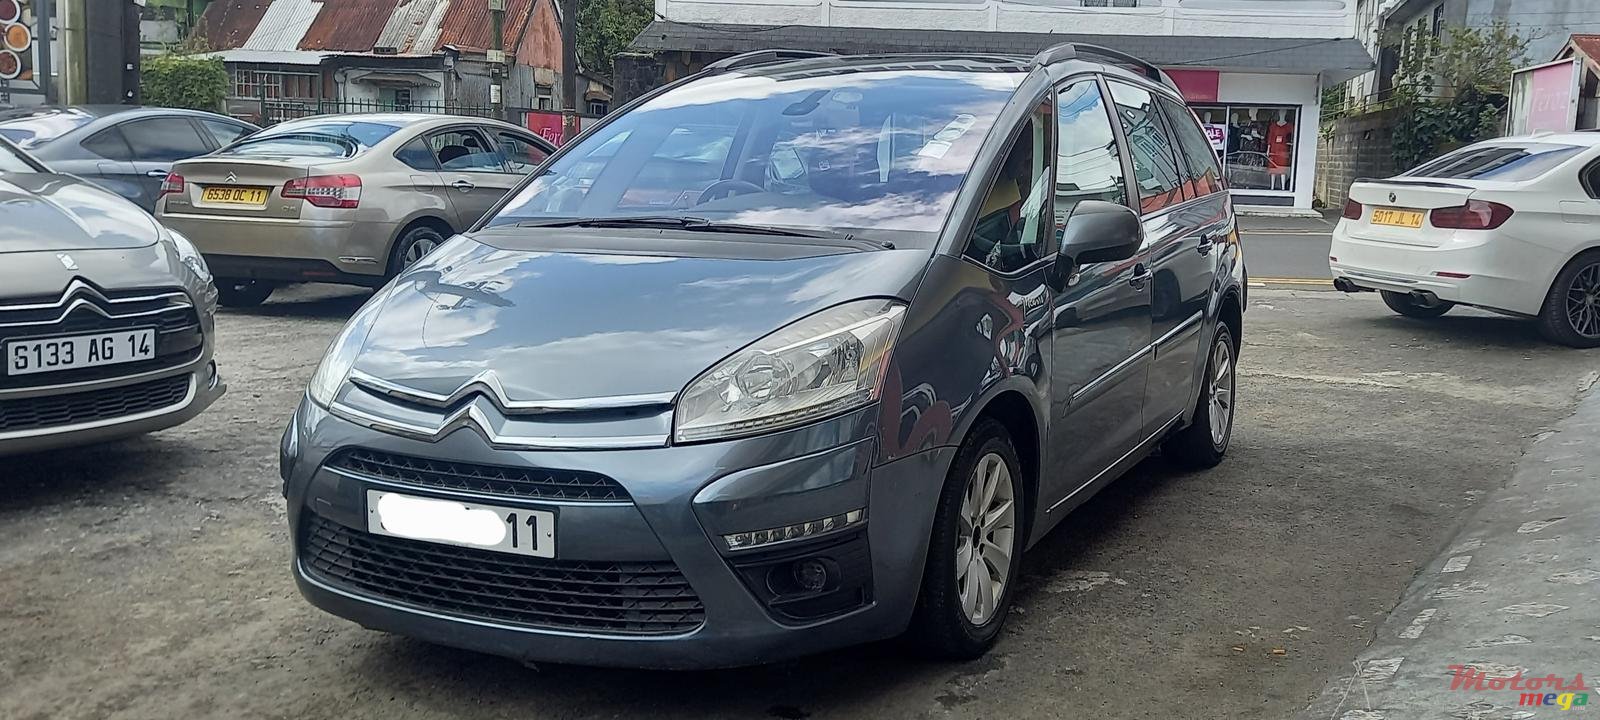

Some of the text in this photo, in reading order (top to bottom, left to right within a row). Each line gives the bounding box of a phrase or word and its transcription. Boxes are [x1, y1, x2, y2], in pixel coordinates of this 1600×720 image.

[1205, 128, 1222, 138] ALE
[206, 188, 230, 200] 6538
[249, 191, 261, 202] 11
[1372, 210, 1393, 222] 5017
[88, 337, 114, 363] AG
[128, 333, 150, 357] 14
[506, 512, 538, 551] 11
